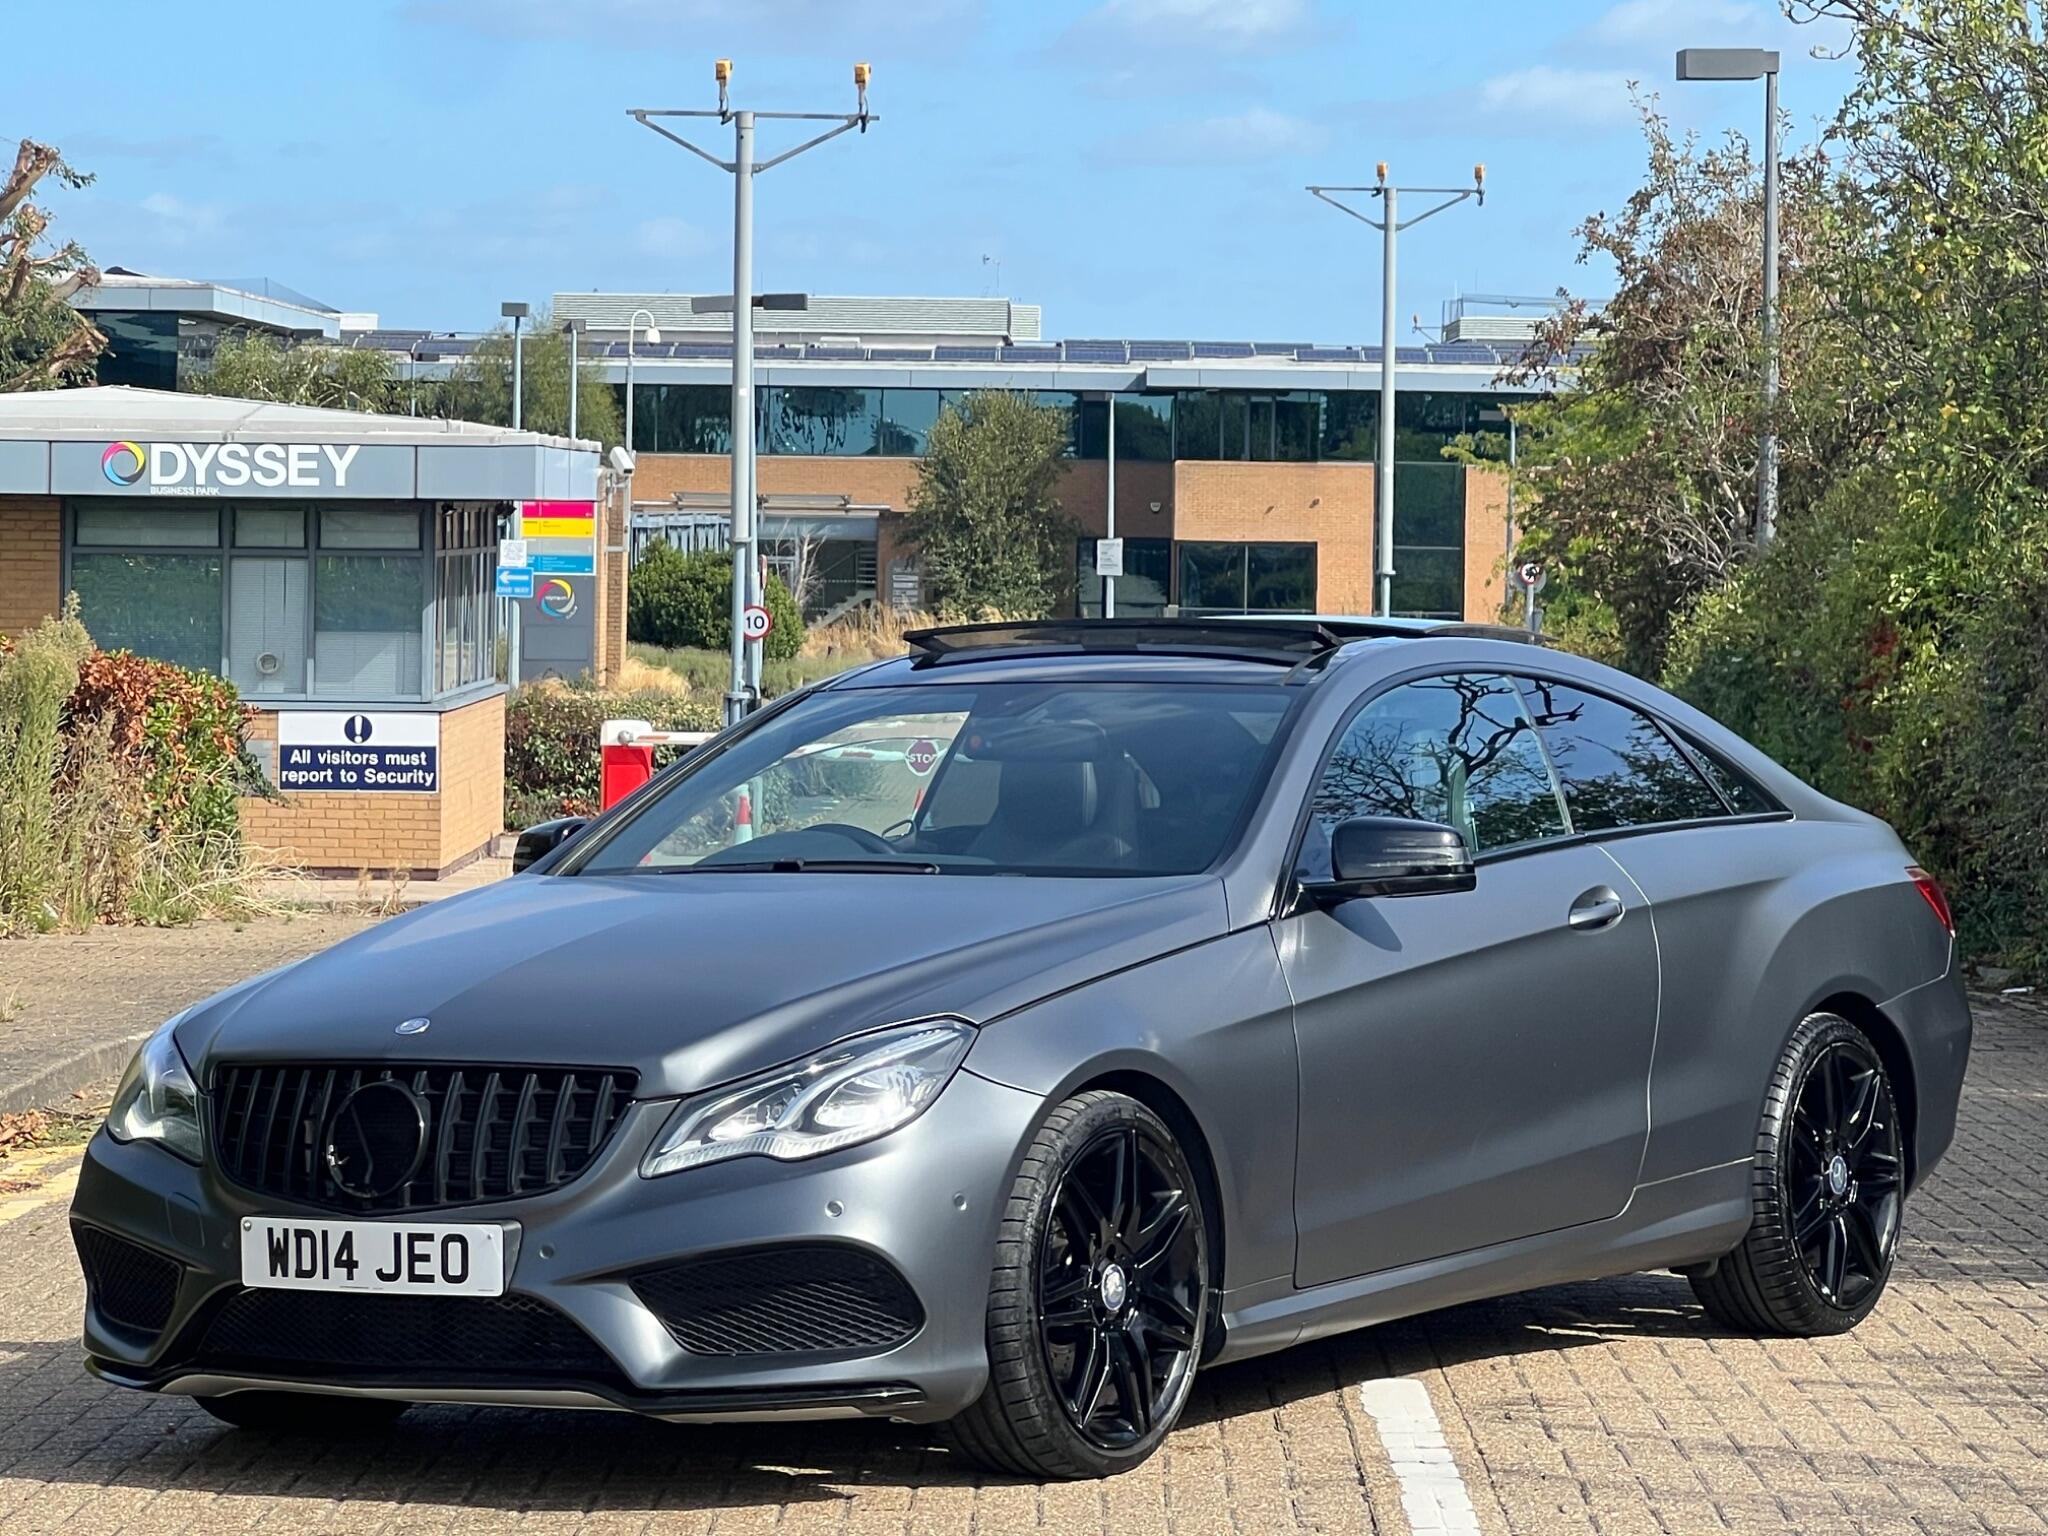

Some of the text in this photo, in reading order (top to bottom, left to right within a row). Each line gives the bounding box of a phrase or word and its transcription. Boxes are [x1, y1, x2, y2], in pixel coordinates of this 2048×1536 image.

[150, 487, 219, 495] BUSINESS PARK
[746, 616, 764, 629] 10
[290, 750, 426, 765] All visitors must
[281, 768, 434, 786] report to Security
[267, 1228, 469, 1284] WD14 JEO
